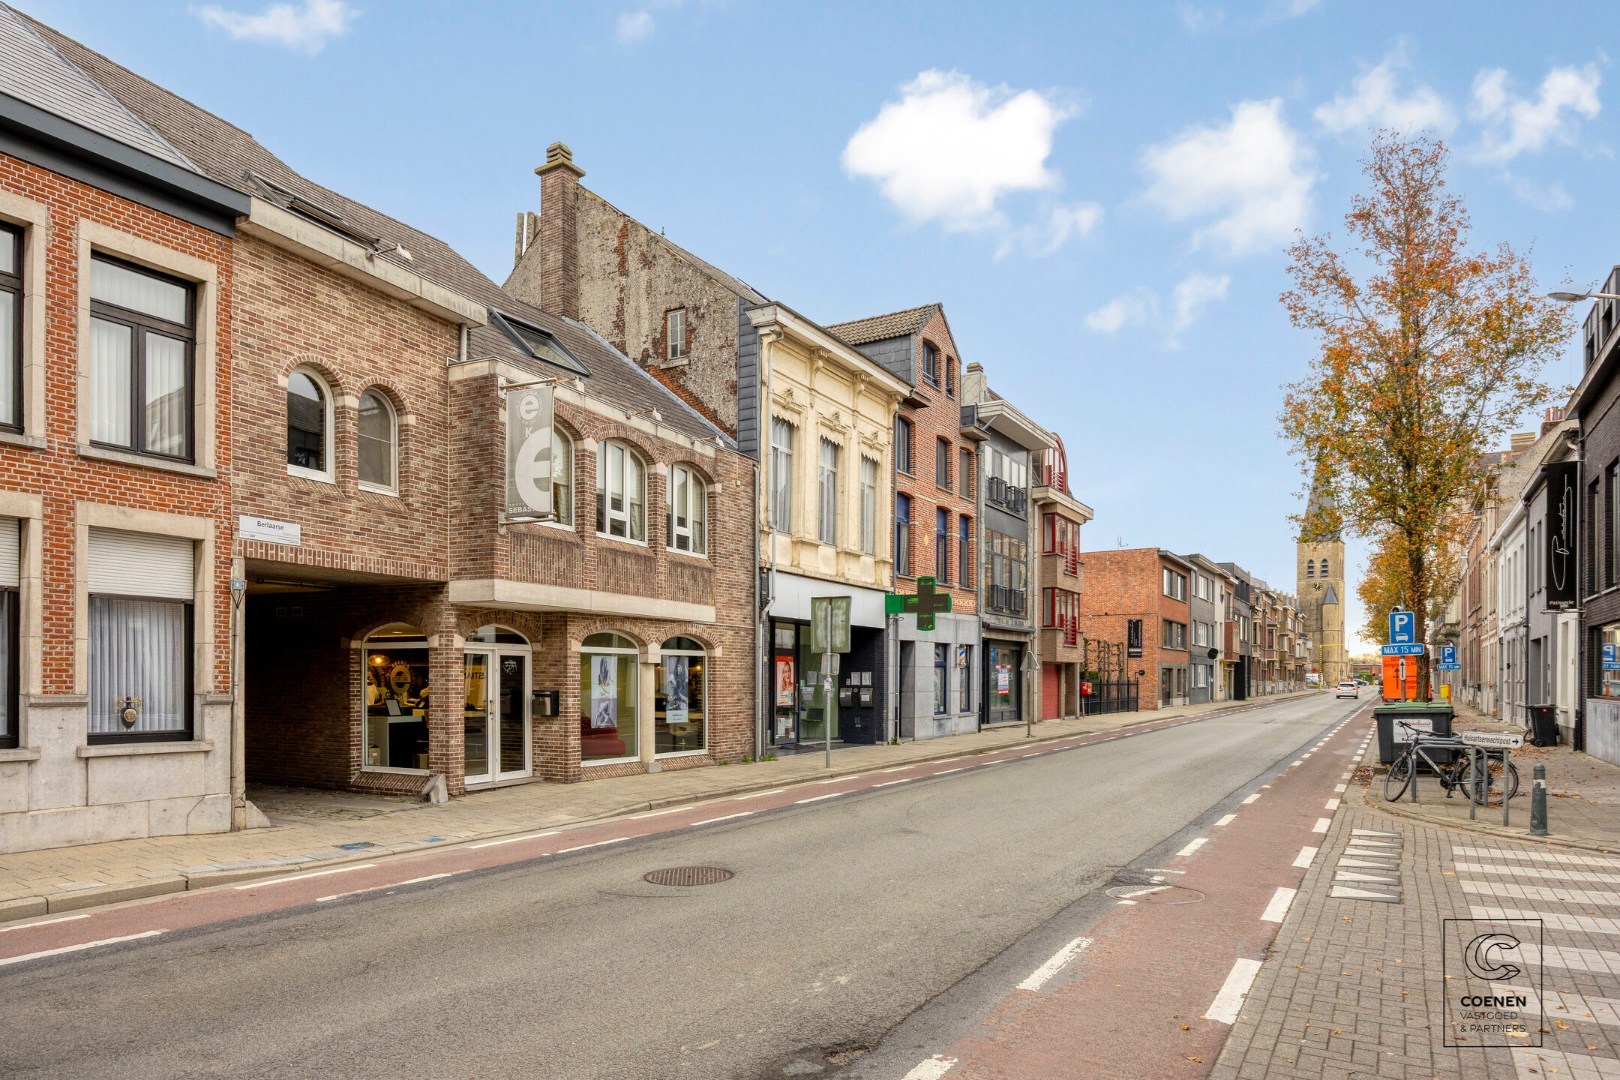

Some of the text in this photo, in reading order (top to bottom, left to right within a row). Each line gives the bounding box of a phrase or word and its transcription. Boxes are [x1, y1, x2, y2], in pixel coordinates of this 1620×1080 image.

[256, 520, 285, 531] Berlaarse
[1395, 614, 1408, 632] P
[1383, 646, 1399, 654] MAX
[1401, 646, 1409, 654] 15
[1444, 647, 1453, 657] P
[1464, 734, 1511, 746] Huisartsenwachtpost
